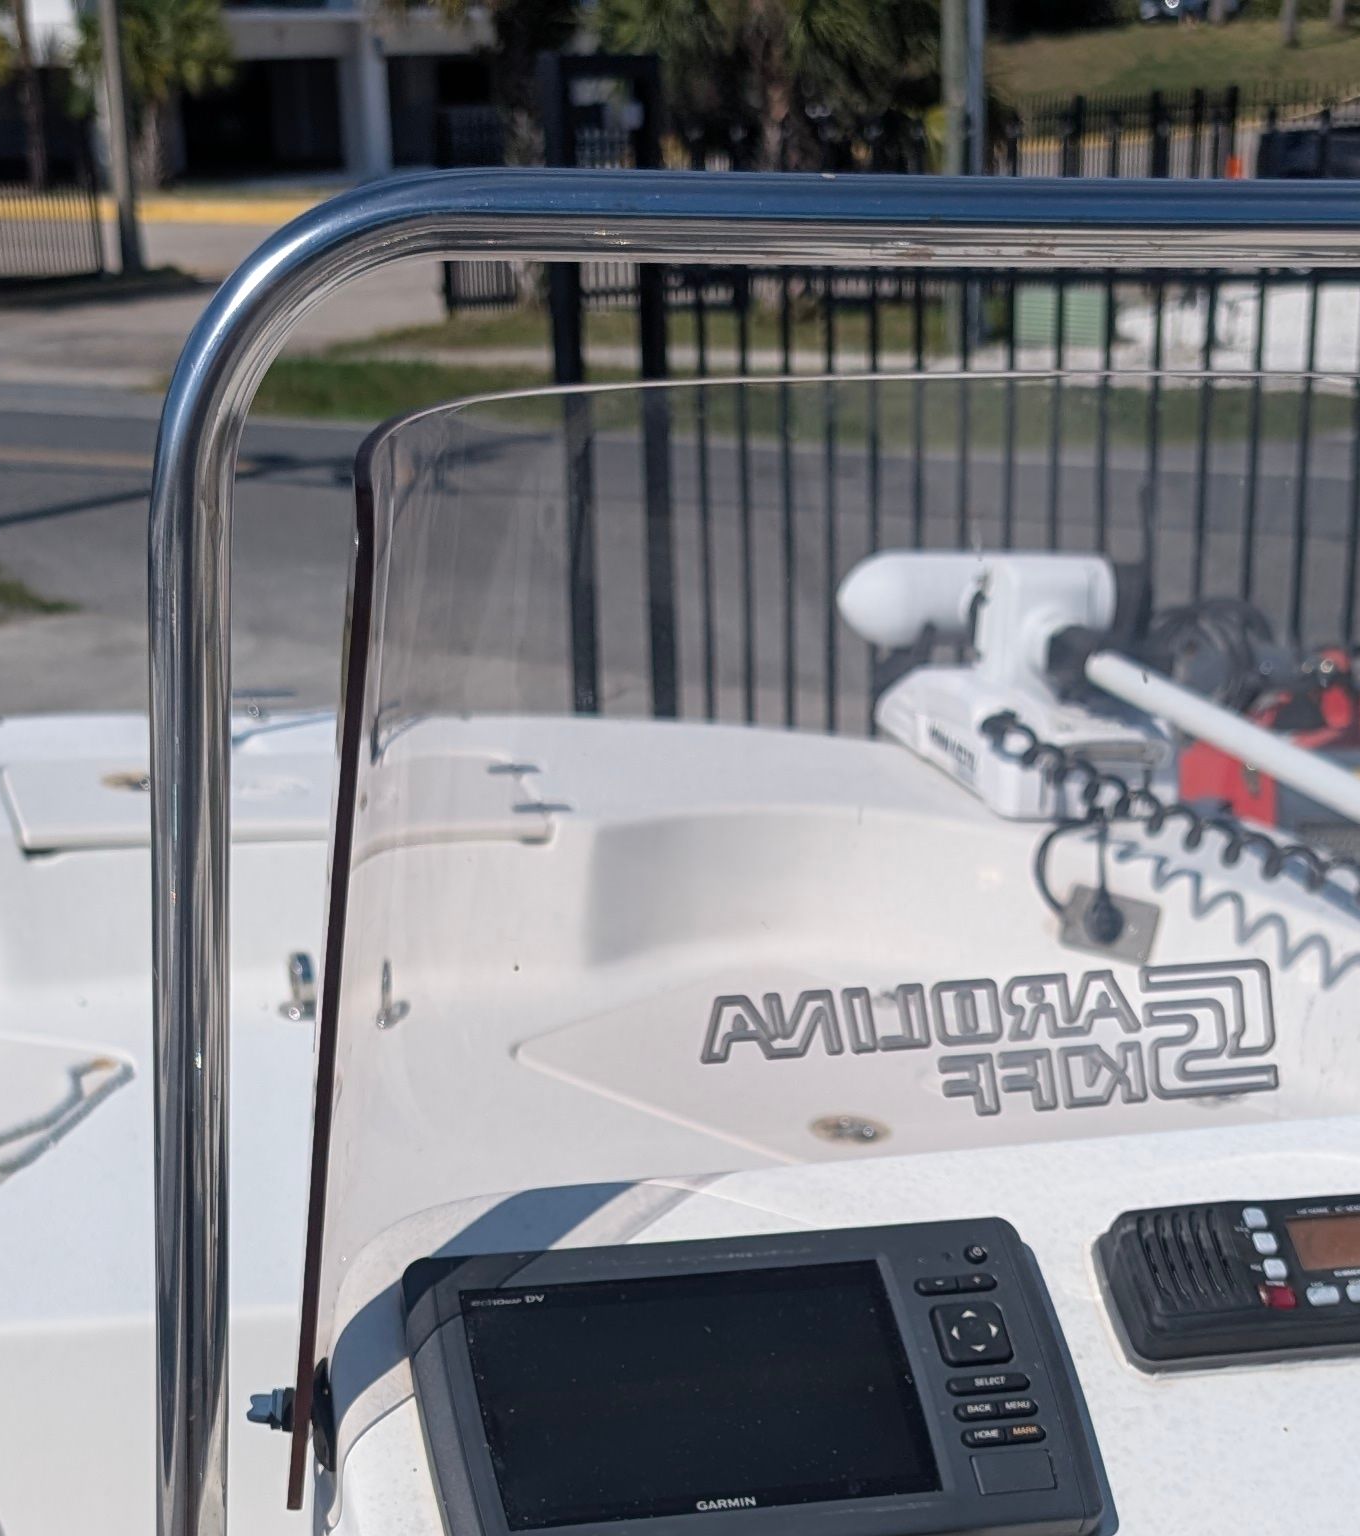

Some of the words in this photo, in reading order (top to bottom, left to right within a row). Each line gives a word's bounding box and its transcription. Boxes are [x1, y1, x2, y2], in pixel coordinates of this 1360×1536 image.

[524, 1294, 545, 1304] DV
[974, 1375, 1007, 1388] SELECT
[966, 1403, 993, 1414] BACK
[1004, 1400, 1031, 1410] MENU
[973, 1428, 999, 1440] HOME
[1012, 1425, 1038, 1436] MARK
[695, 1496, 757, 1511] GARMIN
